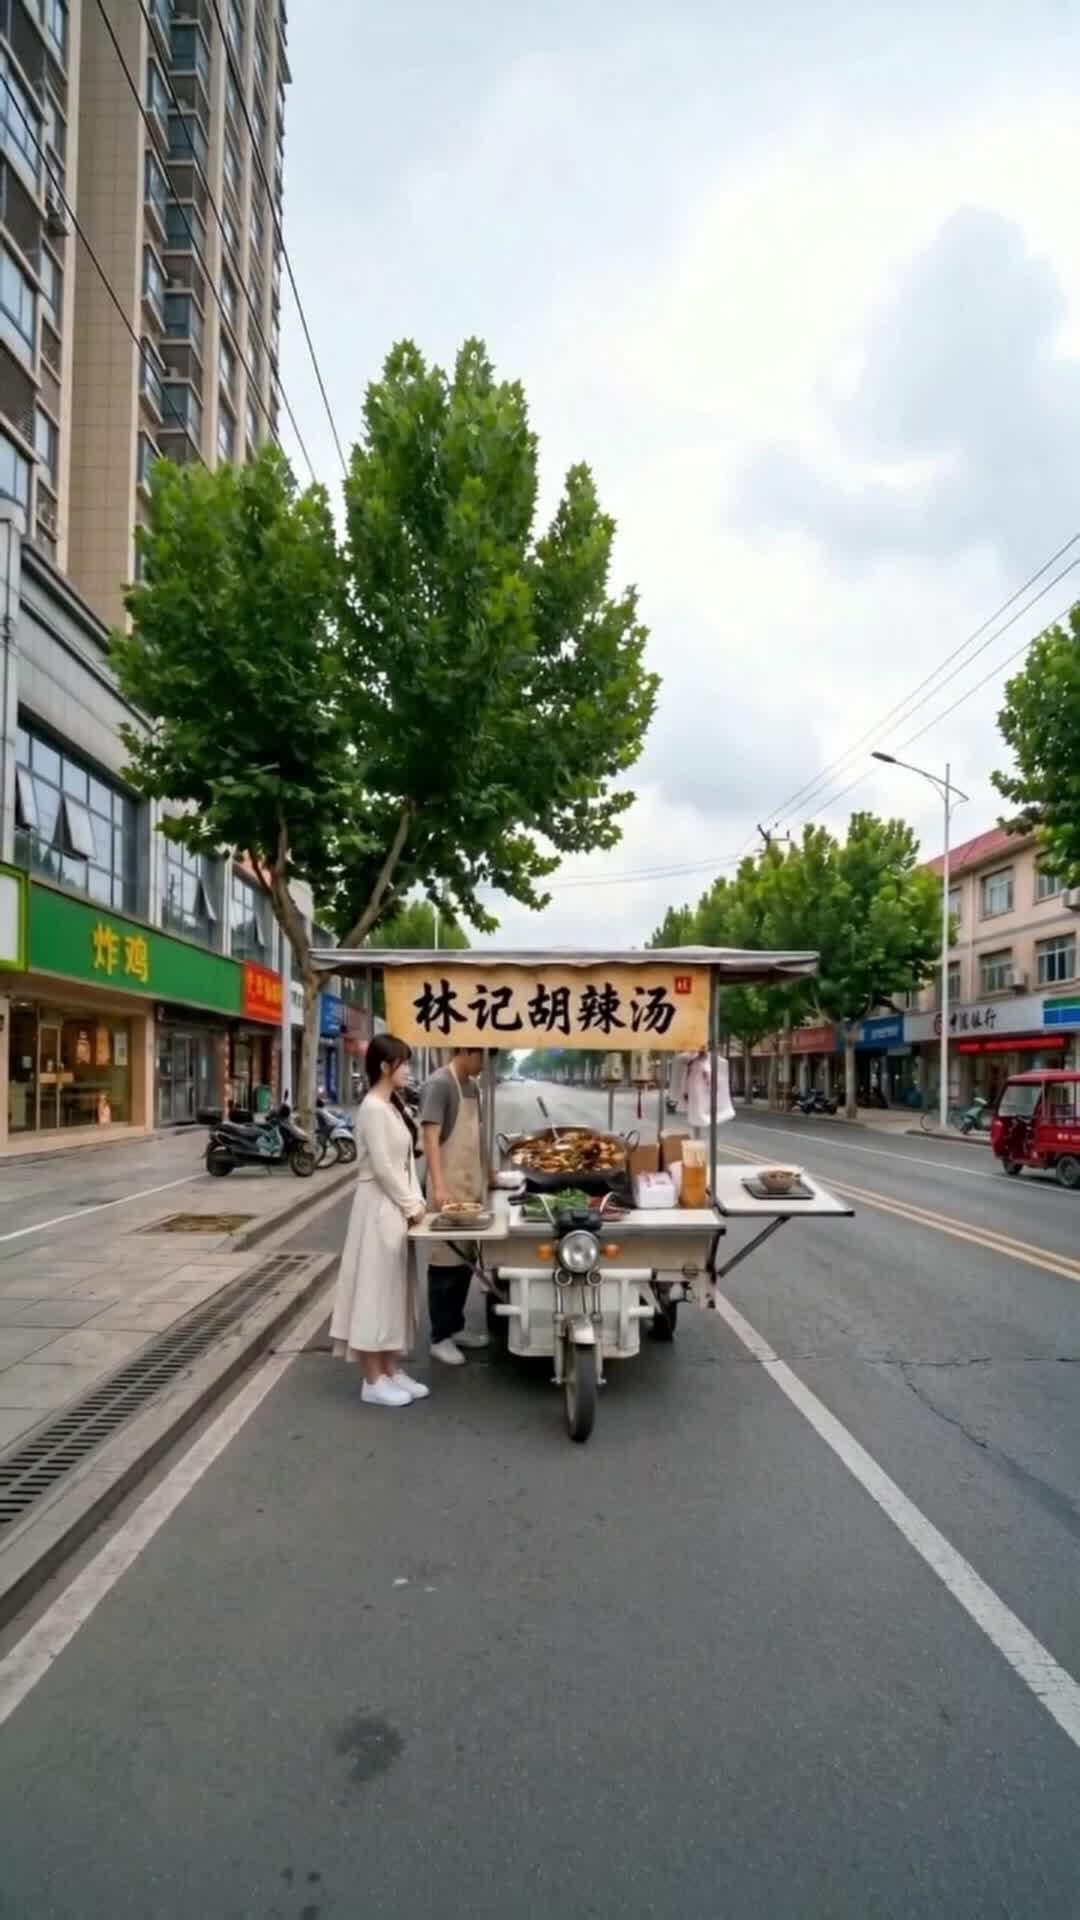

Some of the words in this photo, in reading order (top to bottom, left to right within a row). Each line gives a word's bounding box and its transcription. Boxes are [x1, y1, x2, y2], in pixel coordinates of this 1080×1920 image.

[92, 923, 149, 983] 炸鸡
[413, 980, 676, 1035] 林记胡辣汤
